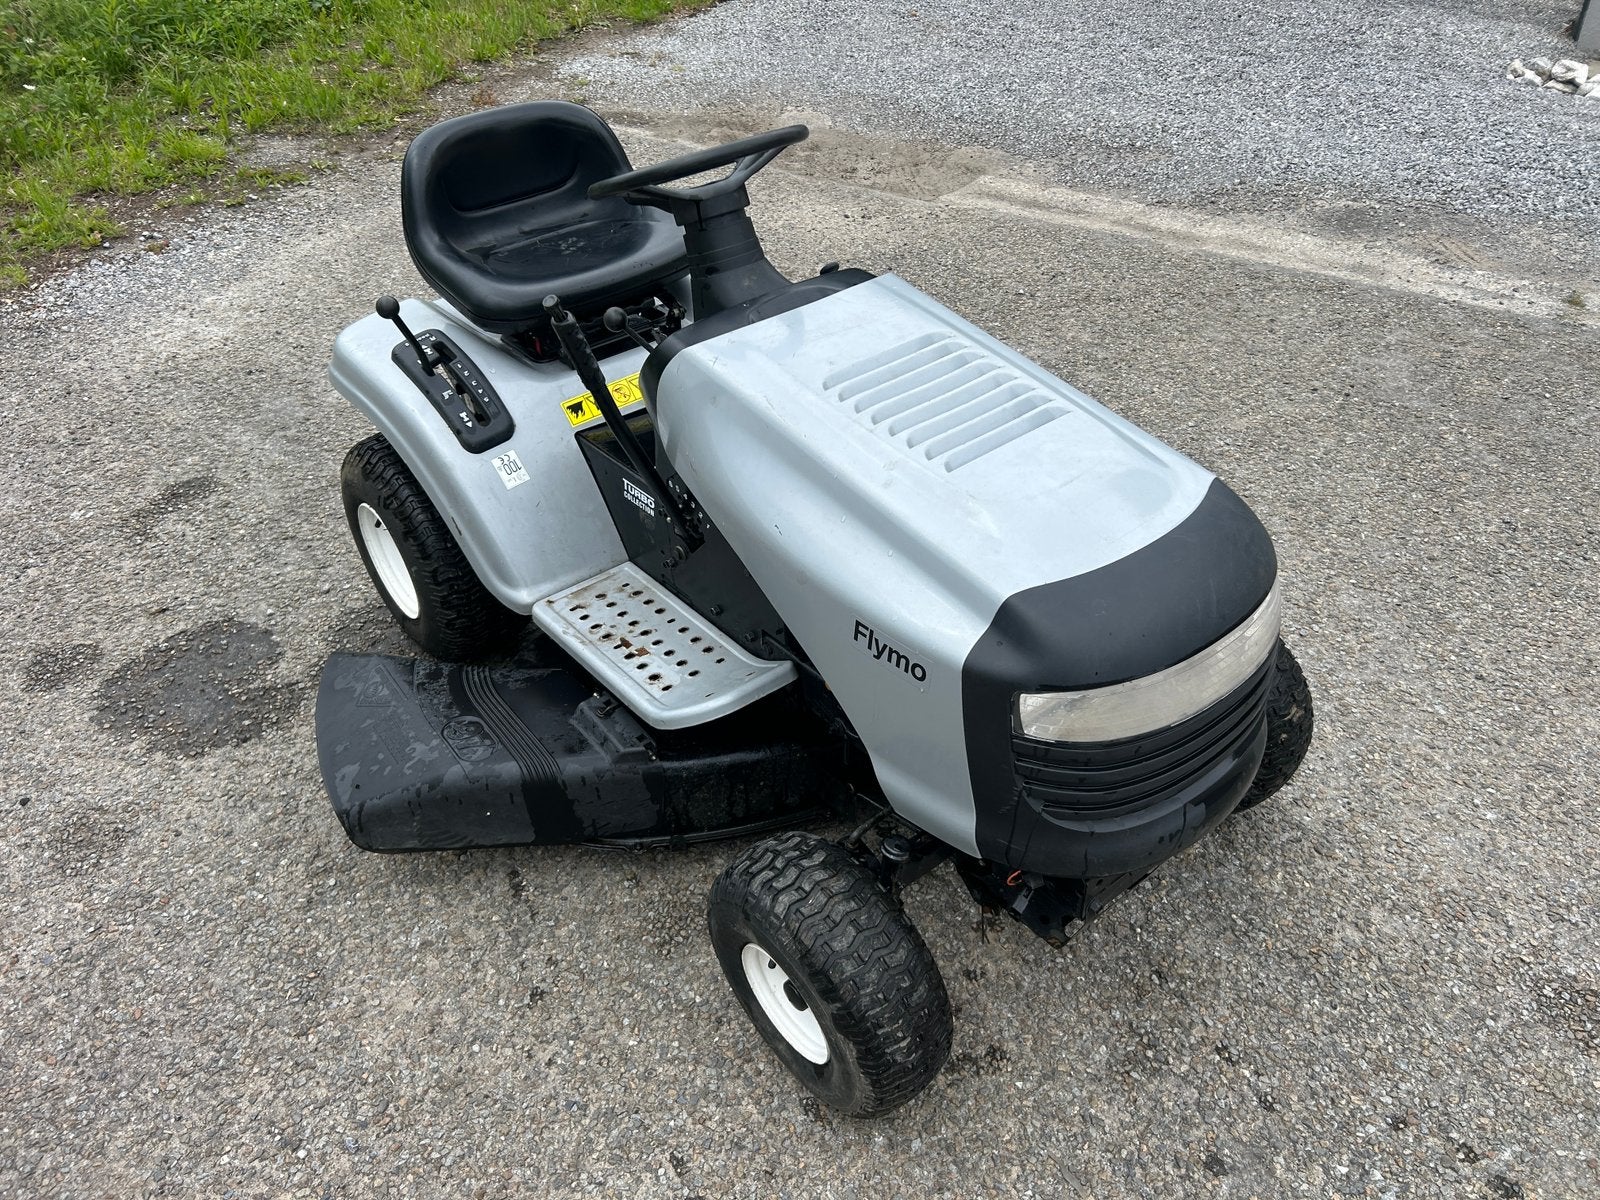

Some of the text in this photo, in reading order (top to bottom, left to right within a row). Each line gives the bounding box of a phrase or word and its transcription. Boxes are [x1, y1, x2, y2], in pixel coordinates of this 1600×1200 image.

[503, 459, 522, 475] 100
[622, 478, 655, 509] TURBO
[624, 490, 655, 517] COLLECTION
[853, 619, 927, 682] Flymo
